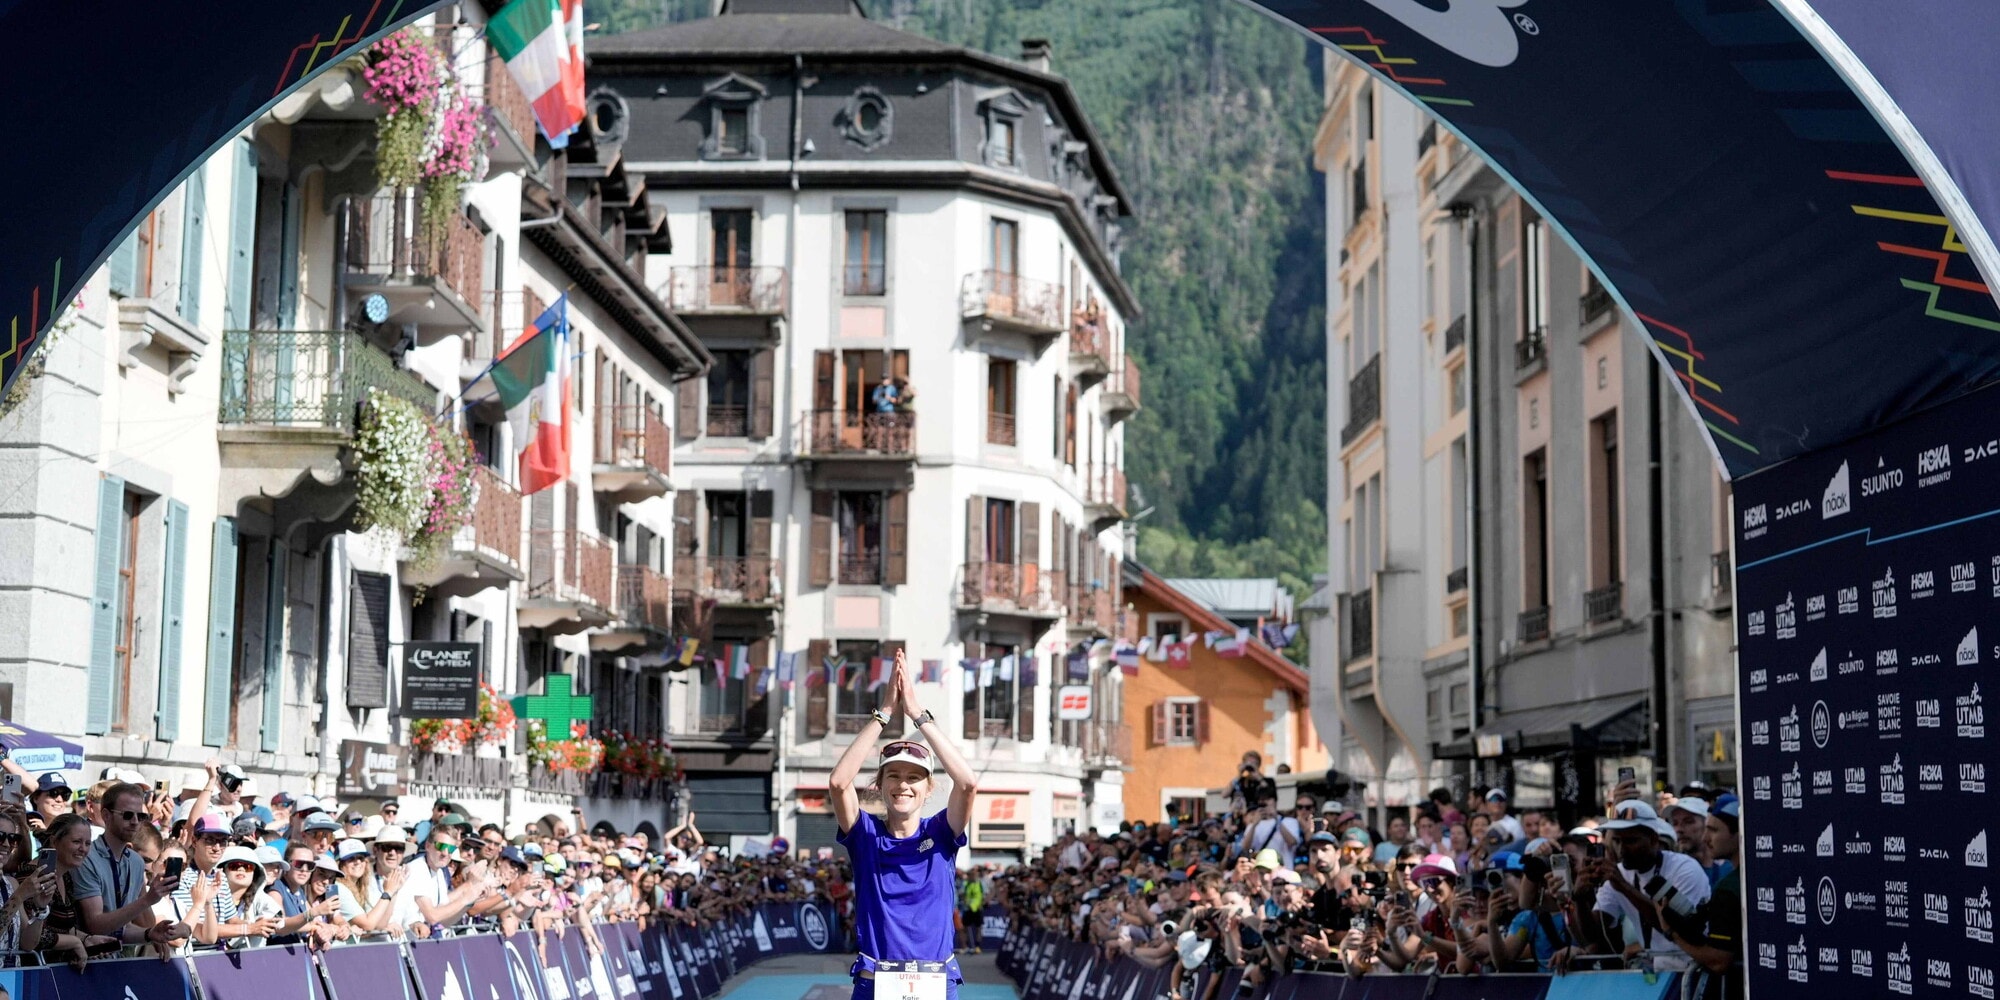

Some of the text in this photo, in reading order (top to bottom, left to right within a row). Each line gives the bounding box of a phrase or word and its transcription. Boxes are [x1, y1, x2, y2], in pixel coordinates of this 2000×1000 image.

[1918, 444, 1951, 475] HOKA
[1964, 439, 2000, 463] DAC
[1861, 469, 1904, 497] SUUNTO
[1744, 503, 1767, 530] HOKA
[1776, 499, 1811, 520] DACIA
[1950, 562, 1976, 582] UTMB
[1911, 571, 1934, 591] HOKA
[1806, 594, 1826, 613] HOKA
[1838, 586, 1858, 604] UTMB
[1872, 588, 1897, 607] UTMB
[1748, 610, 1765, 626] UTMB
[1776, 610, 1796, 629] UTMB
[421, 650, 472, 660] PLANET
[1876, 649, 1898, 667] HOKA
[1911, 654, 1941, 666] DACIA
[1838, 659, 1865, 675] SUUNTO
[1750, 668, 1768, 685] HOKA
[1776, 672, 1799, 684] DACIA
[1878, 692, 1900, 706] SAVOIE
[1878, 706, 1897, 718] MONT
[1916, 699, 1940, 717] UTMB
[1956, 705, 1984, 725] UTMB
[1751, 720, 1769, 735] UTMB
[1780, 724, 1800, 741] UTMB
[1879, 718, 1901, 731] BLANC
[1813, 771, 1833, 787] HOKA
[1845, 767, 1866, 783] UTMB
[1920, 764, 1943, 781] HOKA
[1960, 763, 1985, 780] UTMB
[1753, 776, 1771, 790] UTMB
[1782, 781, 1802, 798] UTMB
[1880, 774, 1905, 792] UTMB
[1755, 835, 1773, 850] HOKA
[1782, 844, 1806, 853] DACIA
[1845, 842, 1872, 854] SUUNTO
[1884, 836, 1906, 853] HOKA
[1919, 848, 1950, 859] DACIA
[1757, 887, 1775, 901] UTMB
[1885, 880, 1908, 893] SAVOIE
[1786, 897, 1806, 913] UTMB
[1885, 893, 1903, 905] MONT
[1924, 893, 1948, 912] UTMB
[1886, 906, 1909, 919] BLANC
[1965, 908, 1993, 929] UTMB
[1759, 943, 1776, 958] UTMB
[1819, 947, 1839, 963] HOKA
[1852, 949, 1872, 966] UTMB
[1788, 954, 1808, 971] UTMB
[1927, 959, 1951, 979] HOKA
[1888, 962, 1912, 982] UTMB
[1968, 965, 1994, 987] UTMB
[908, 981, 915, 993] 1
